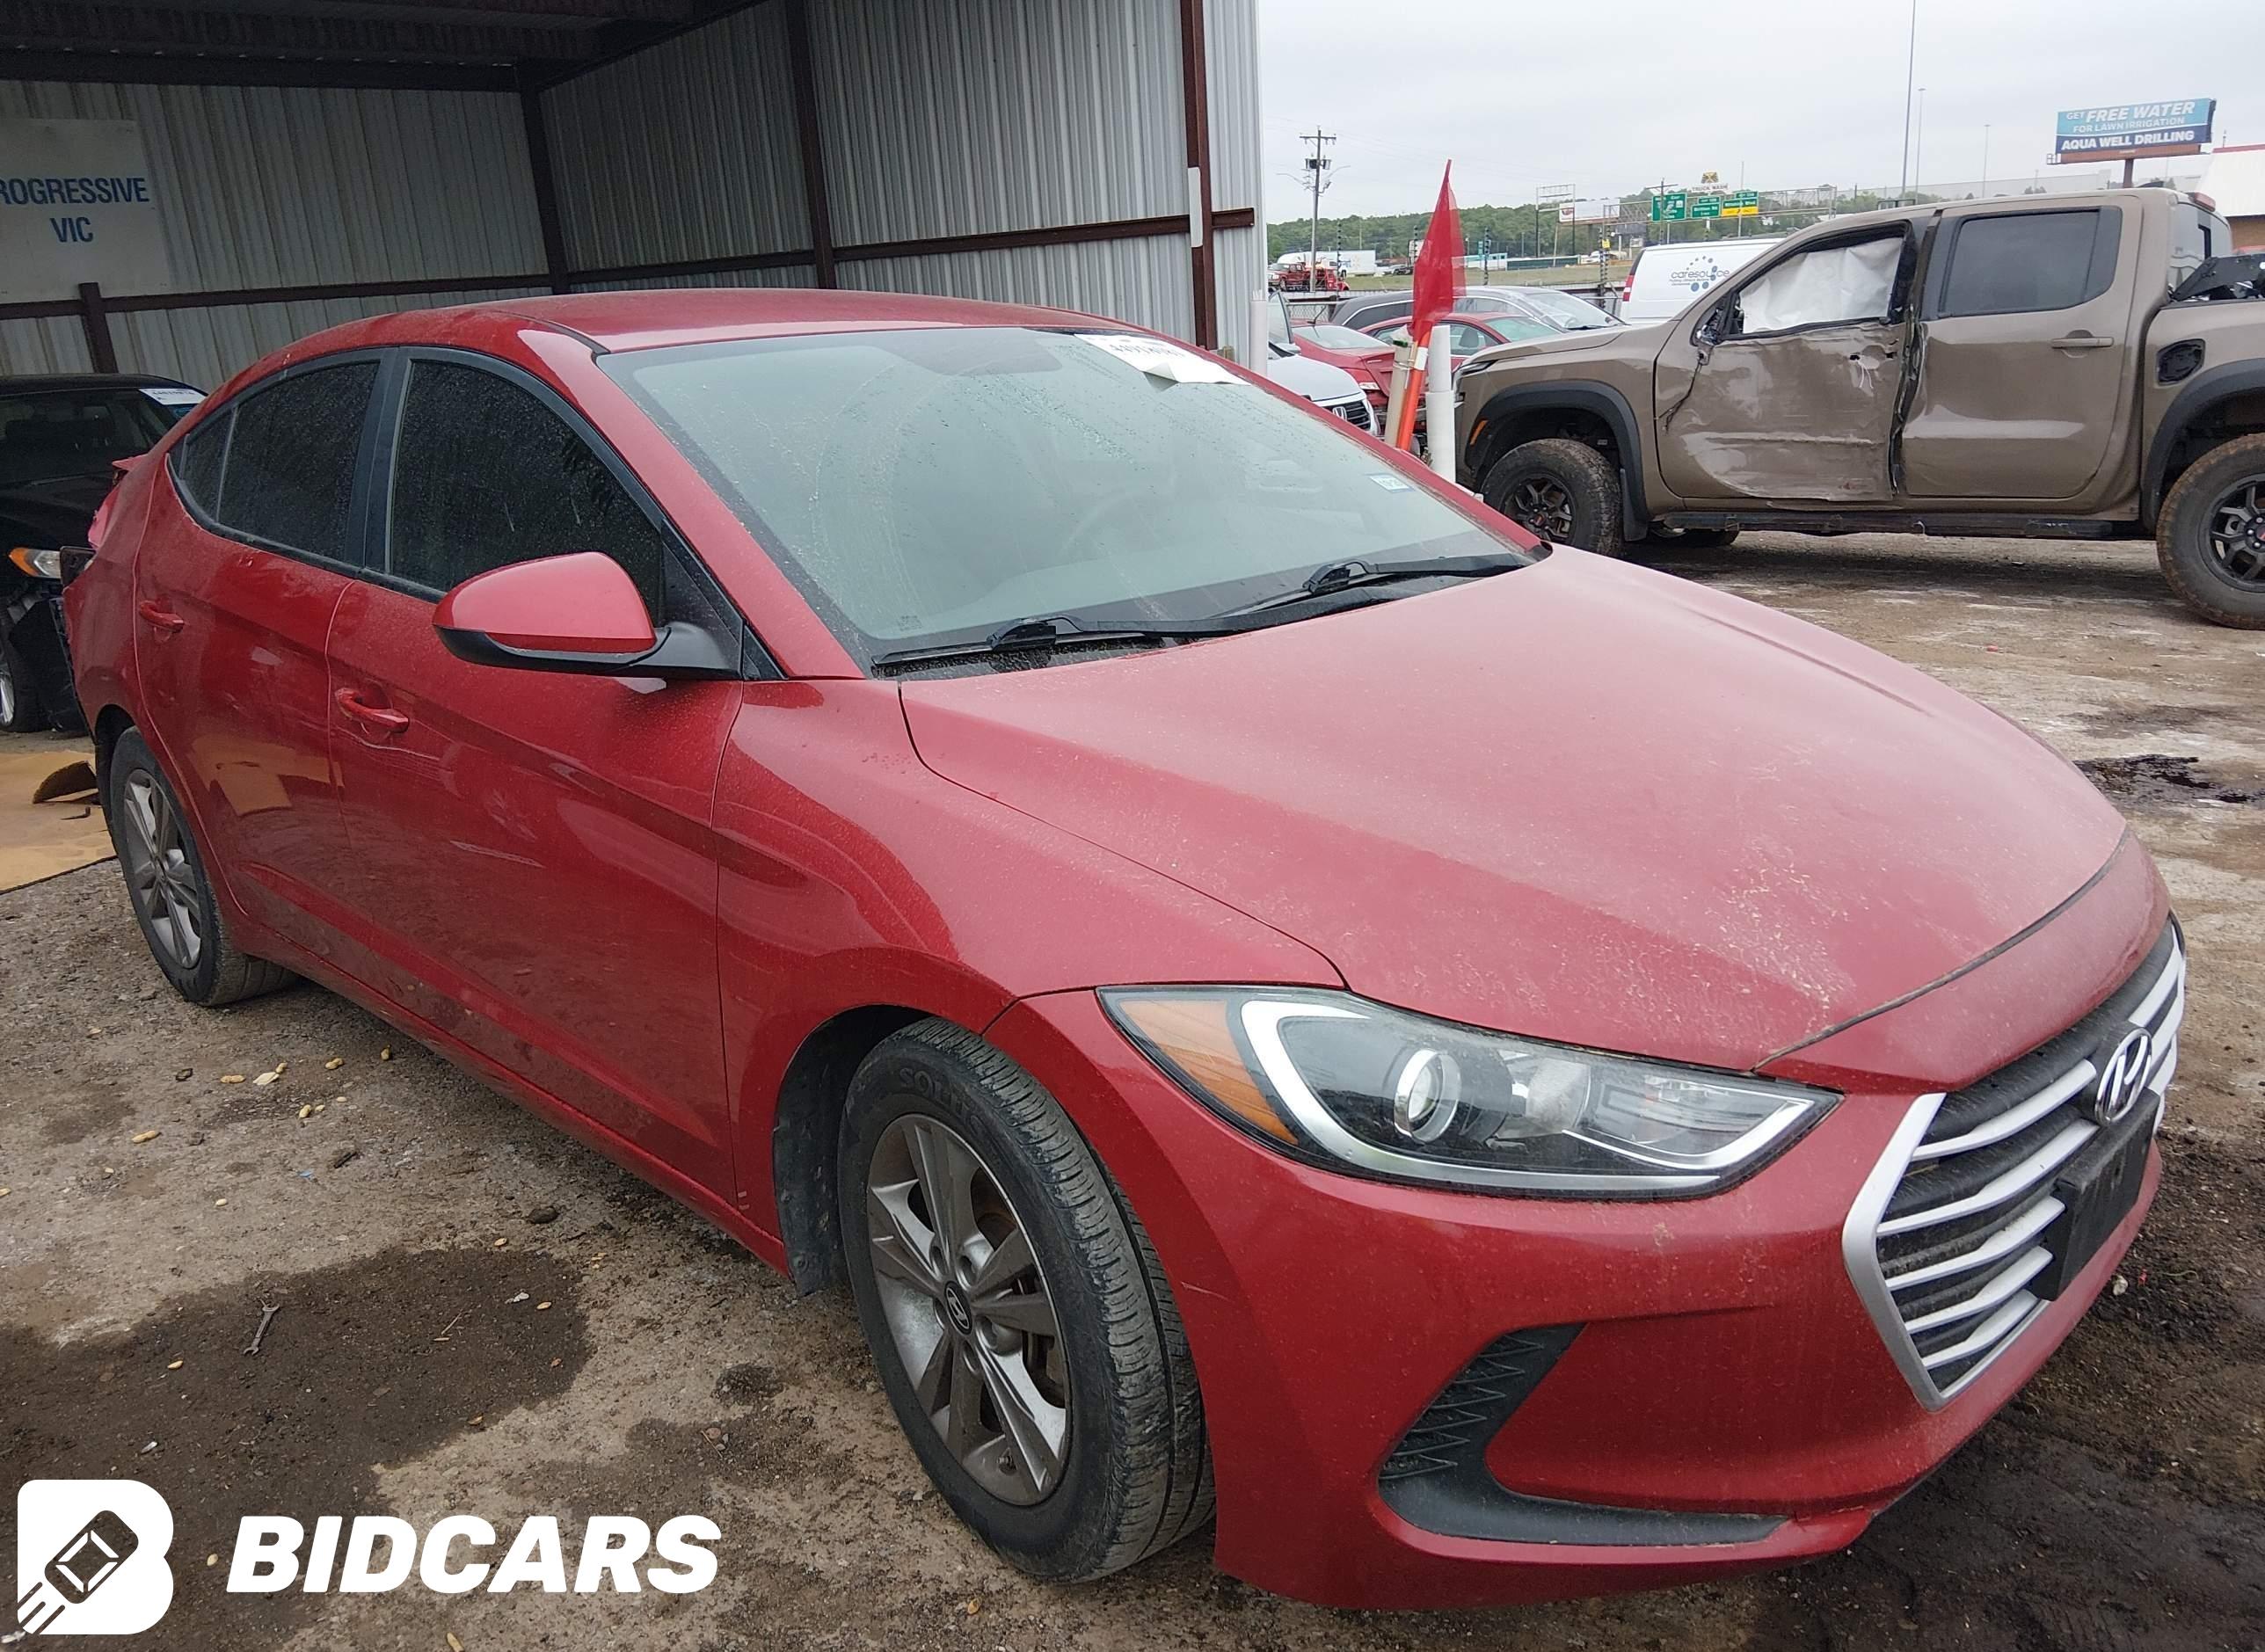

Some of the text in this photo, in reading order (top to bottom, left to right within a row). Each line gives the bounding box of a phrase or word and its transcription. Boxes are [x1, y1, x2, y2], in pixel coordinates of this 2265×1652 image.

[2066, 101, 2196, 123] GET FREE WATER
[2094, 121, 2123, 132] LAWN
[2125, 116, 2185, 129] IRRIGATION
[2061, 130, 2195, 151] AQUA WELL DRILLING
[49, 216, 94, 243] VIC
[1671, 270, 1730, 279] caresouce
